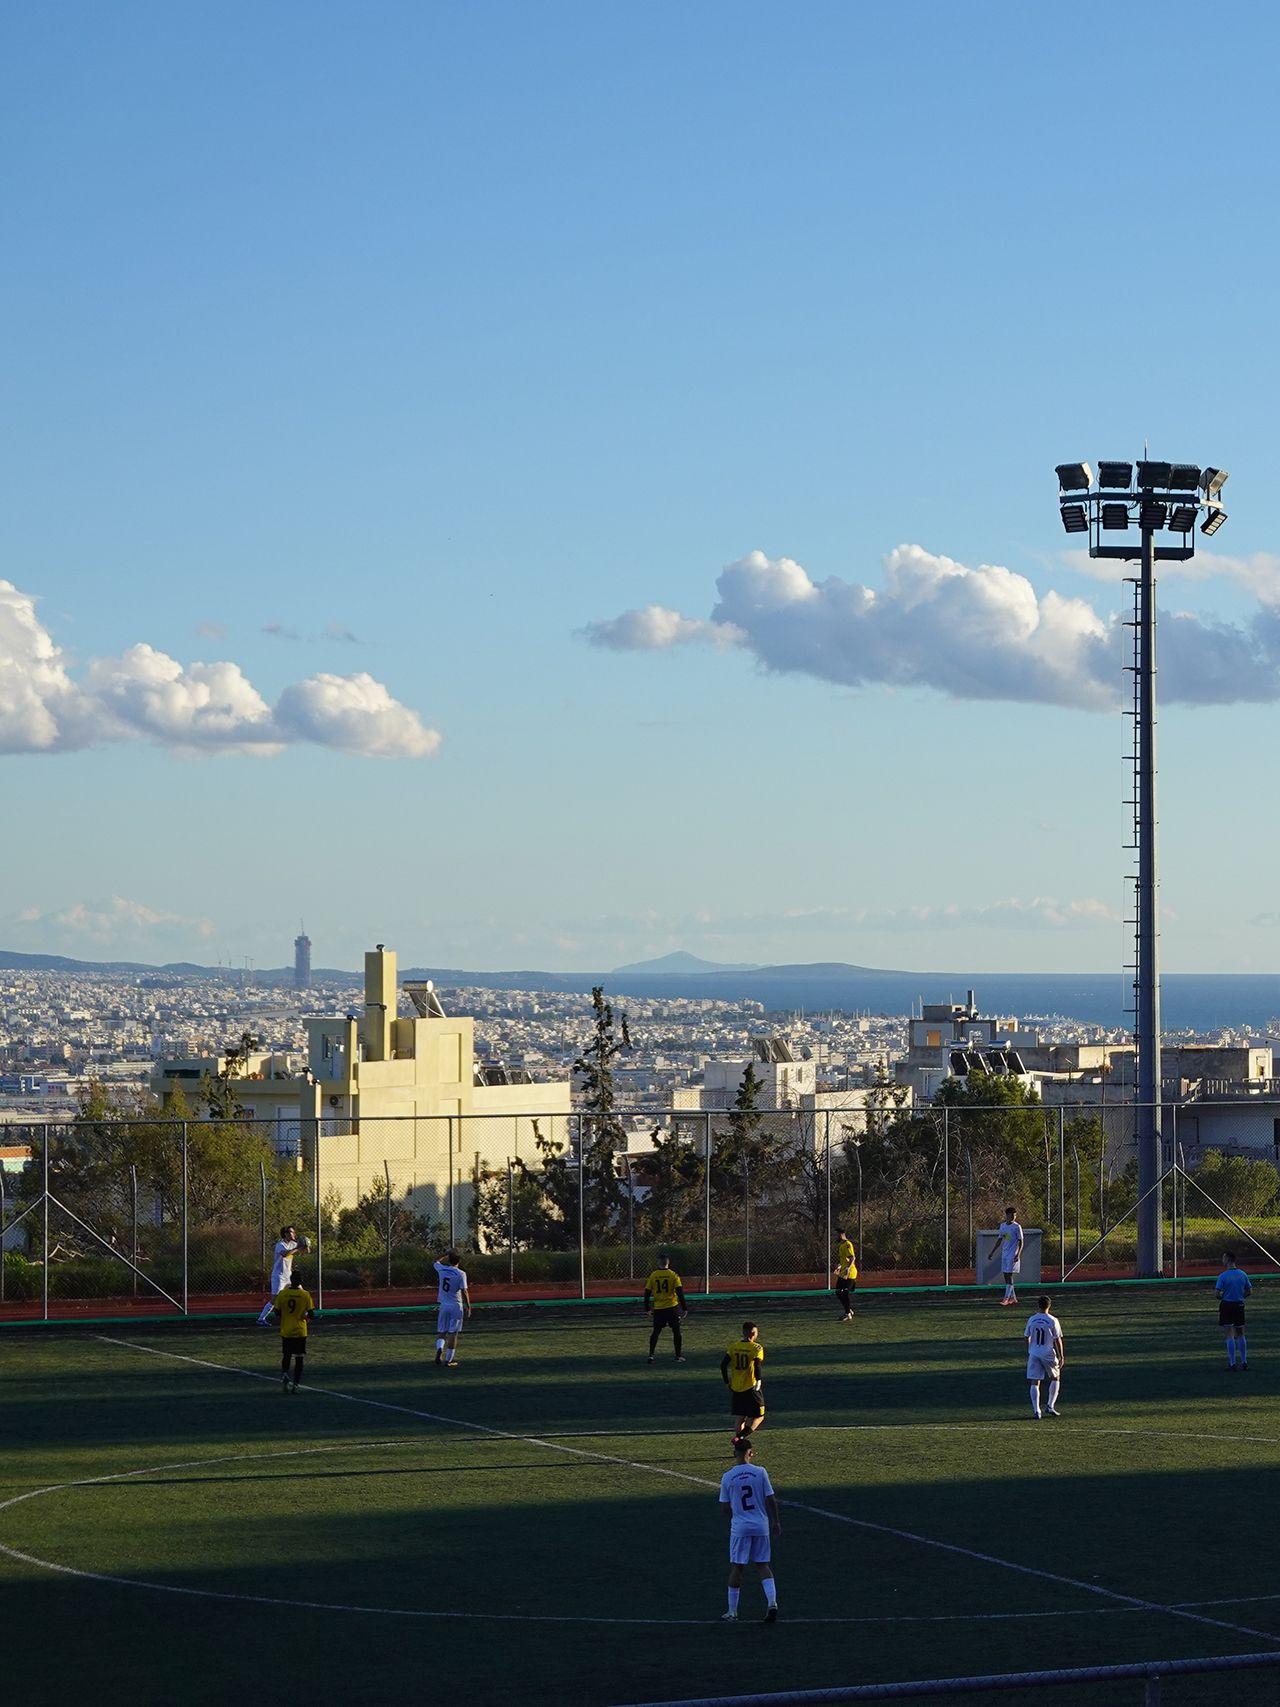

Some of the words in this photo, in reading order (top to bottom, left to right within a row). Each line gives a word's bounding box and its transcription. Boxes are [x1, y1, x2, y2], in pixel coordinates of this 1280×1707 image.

[442, 1277, 450, 1292] 6
[655, 1279, 668, 1294] 14
[287, 1298, 295, 1314] 9
[1035, 1328, 1045, 1346] 11
[734, 1352, 748, 1370] 10
[741, 1485, 755, 1511] 2
